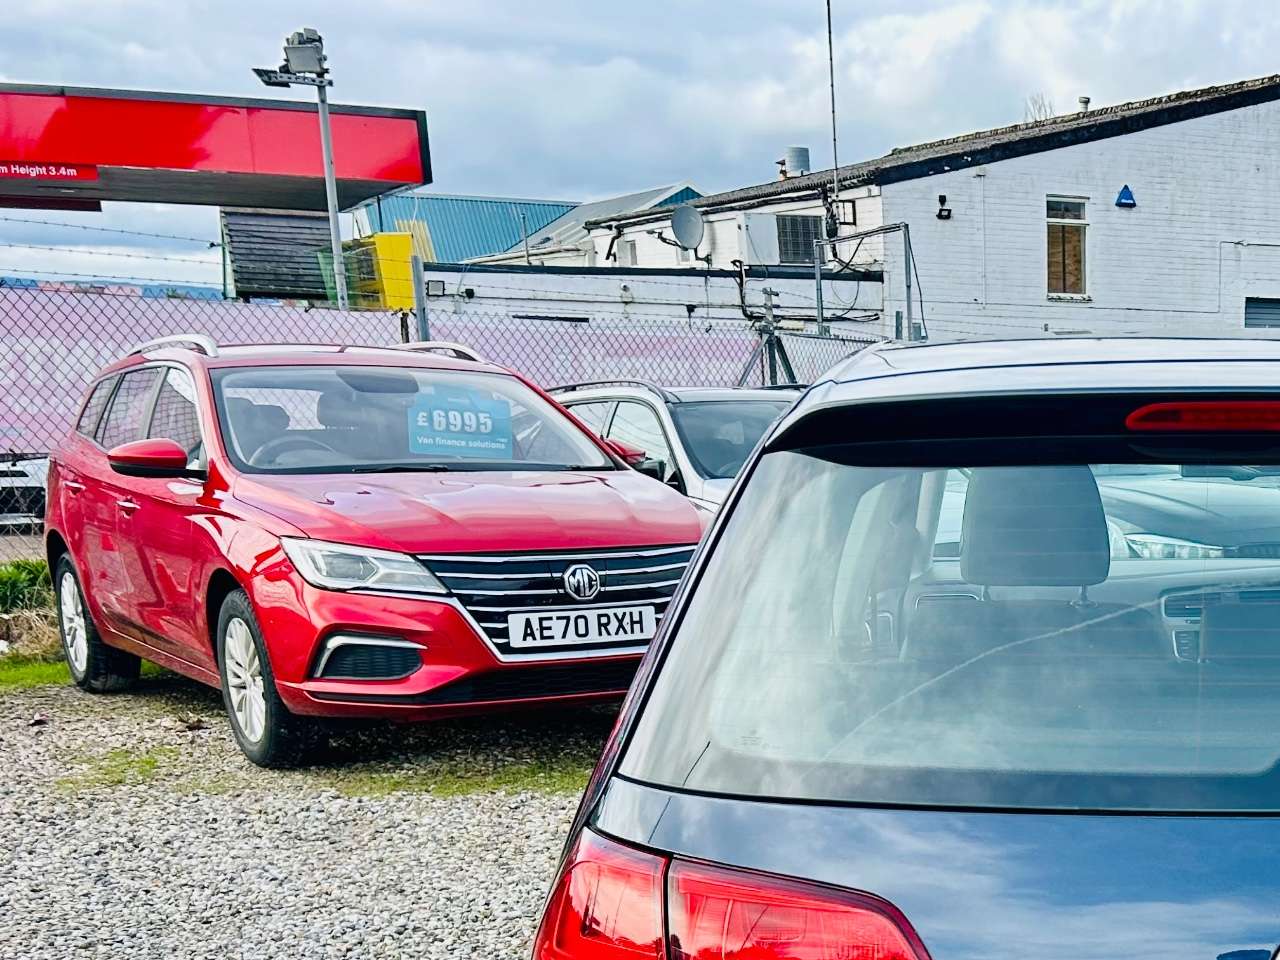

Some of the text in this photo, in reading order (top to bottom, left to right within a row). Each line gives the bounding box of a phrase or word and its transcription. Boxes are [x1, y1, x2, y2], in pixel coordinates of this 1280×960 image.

[10, 164, 47, 177] Height
[49, 166, 77, 176] 3.4m
[432, 409, 492, 433] 6995
[417, 436, 434, 444] Van
[435, 437, 466, 447] finance
[468, 439, 506, 449] solutions
[567, 567, 598, 597] MG
[521, 610, 645, 641] AE70 RXH
